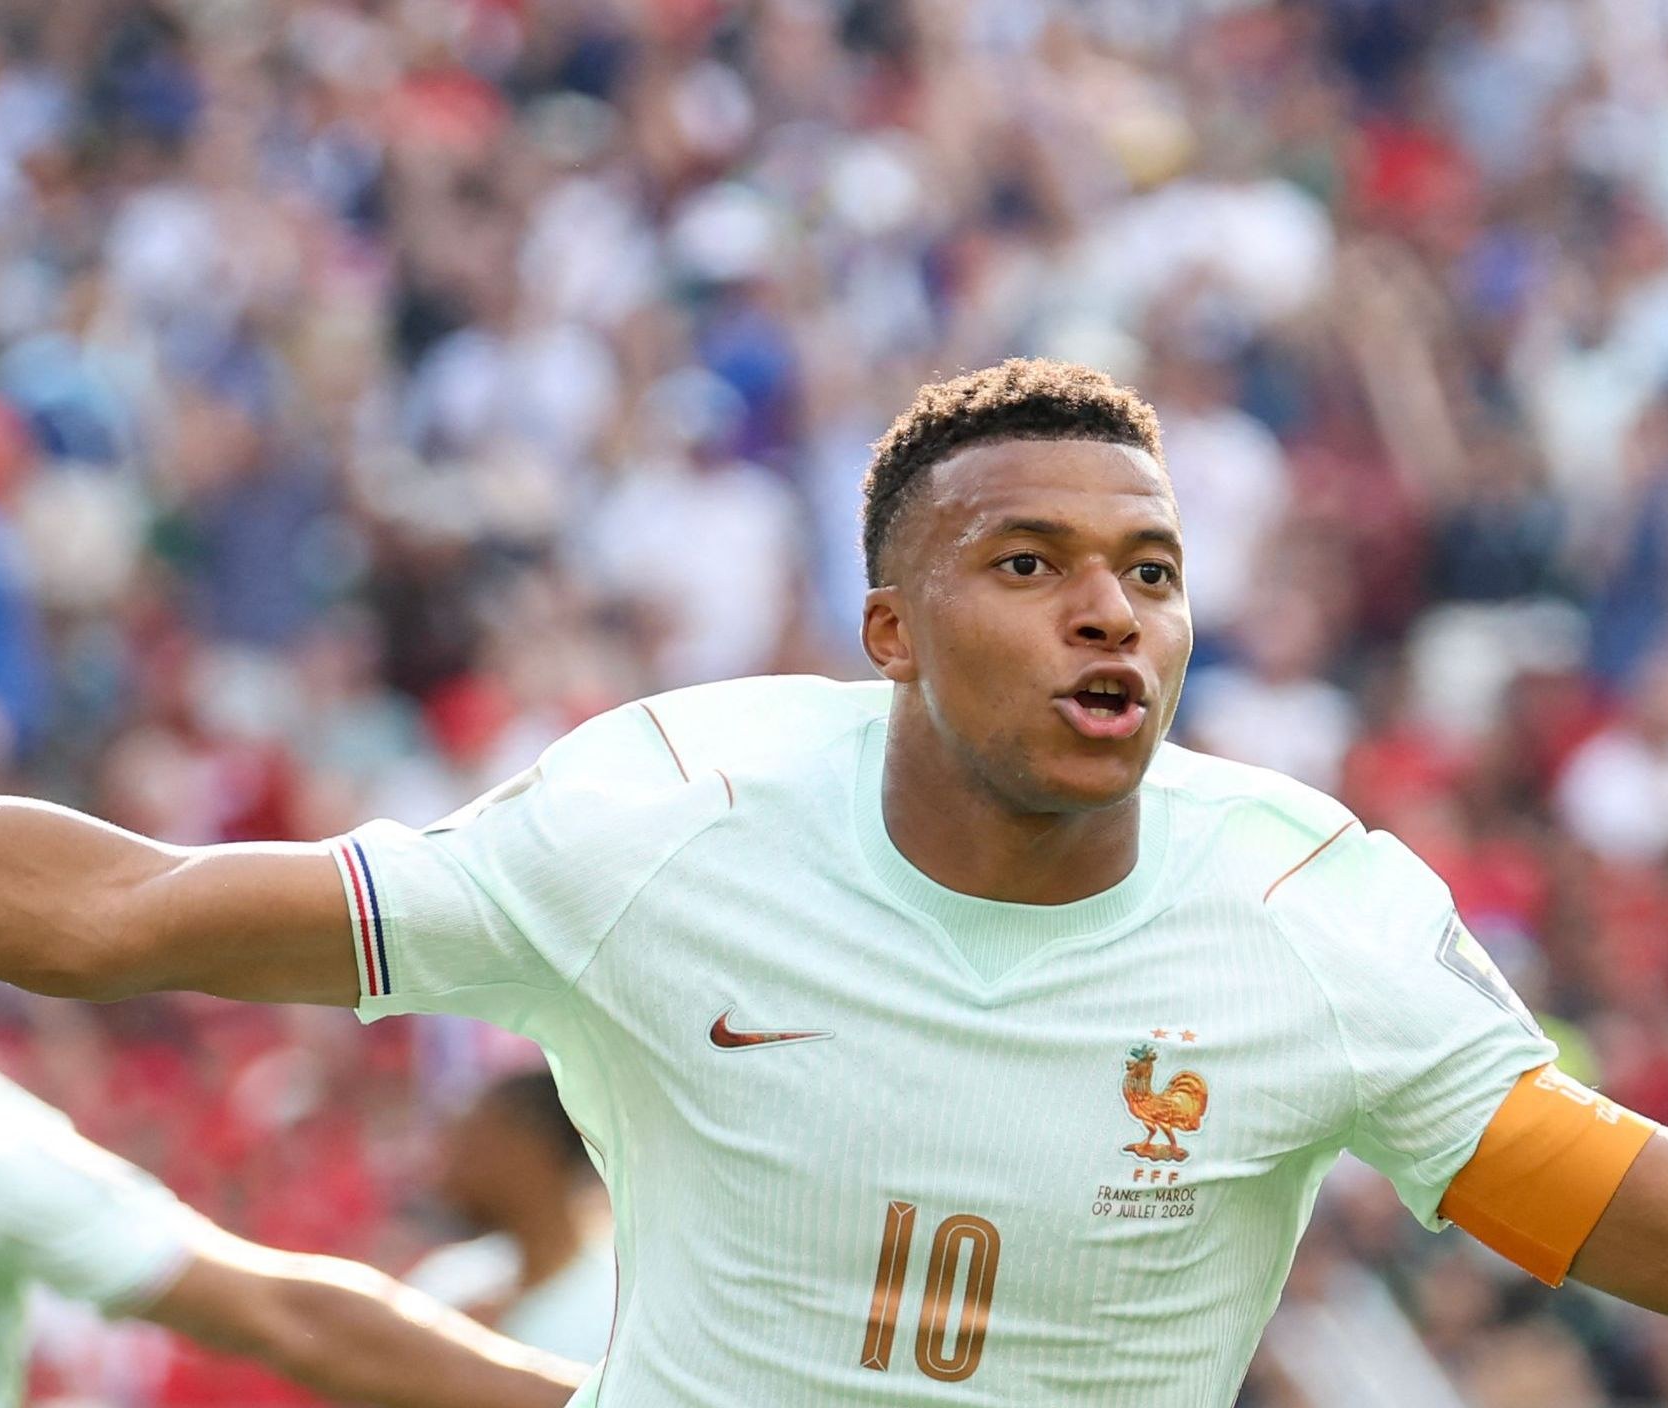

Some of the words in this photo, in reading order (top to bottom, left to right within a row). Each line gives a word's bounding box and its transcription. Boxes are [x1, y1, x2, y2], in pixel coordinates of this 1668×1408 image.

[1097, 1185, 1142, 1202] FRANCE
[1154, 1188, 1198, 1202] MAROC
[1092, 1201, 1112, 1216] 09
[1117, 1204, 1157, 1218] JUILLET
[1161, 1203, 1195, 1218] 2026
[860, 1200, 1001, 1383] 10
